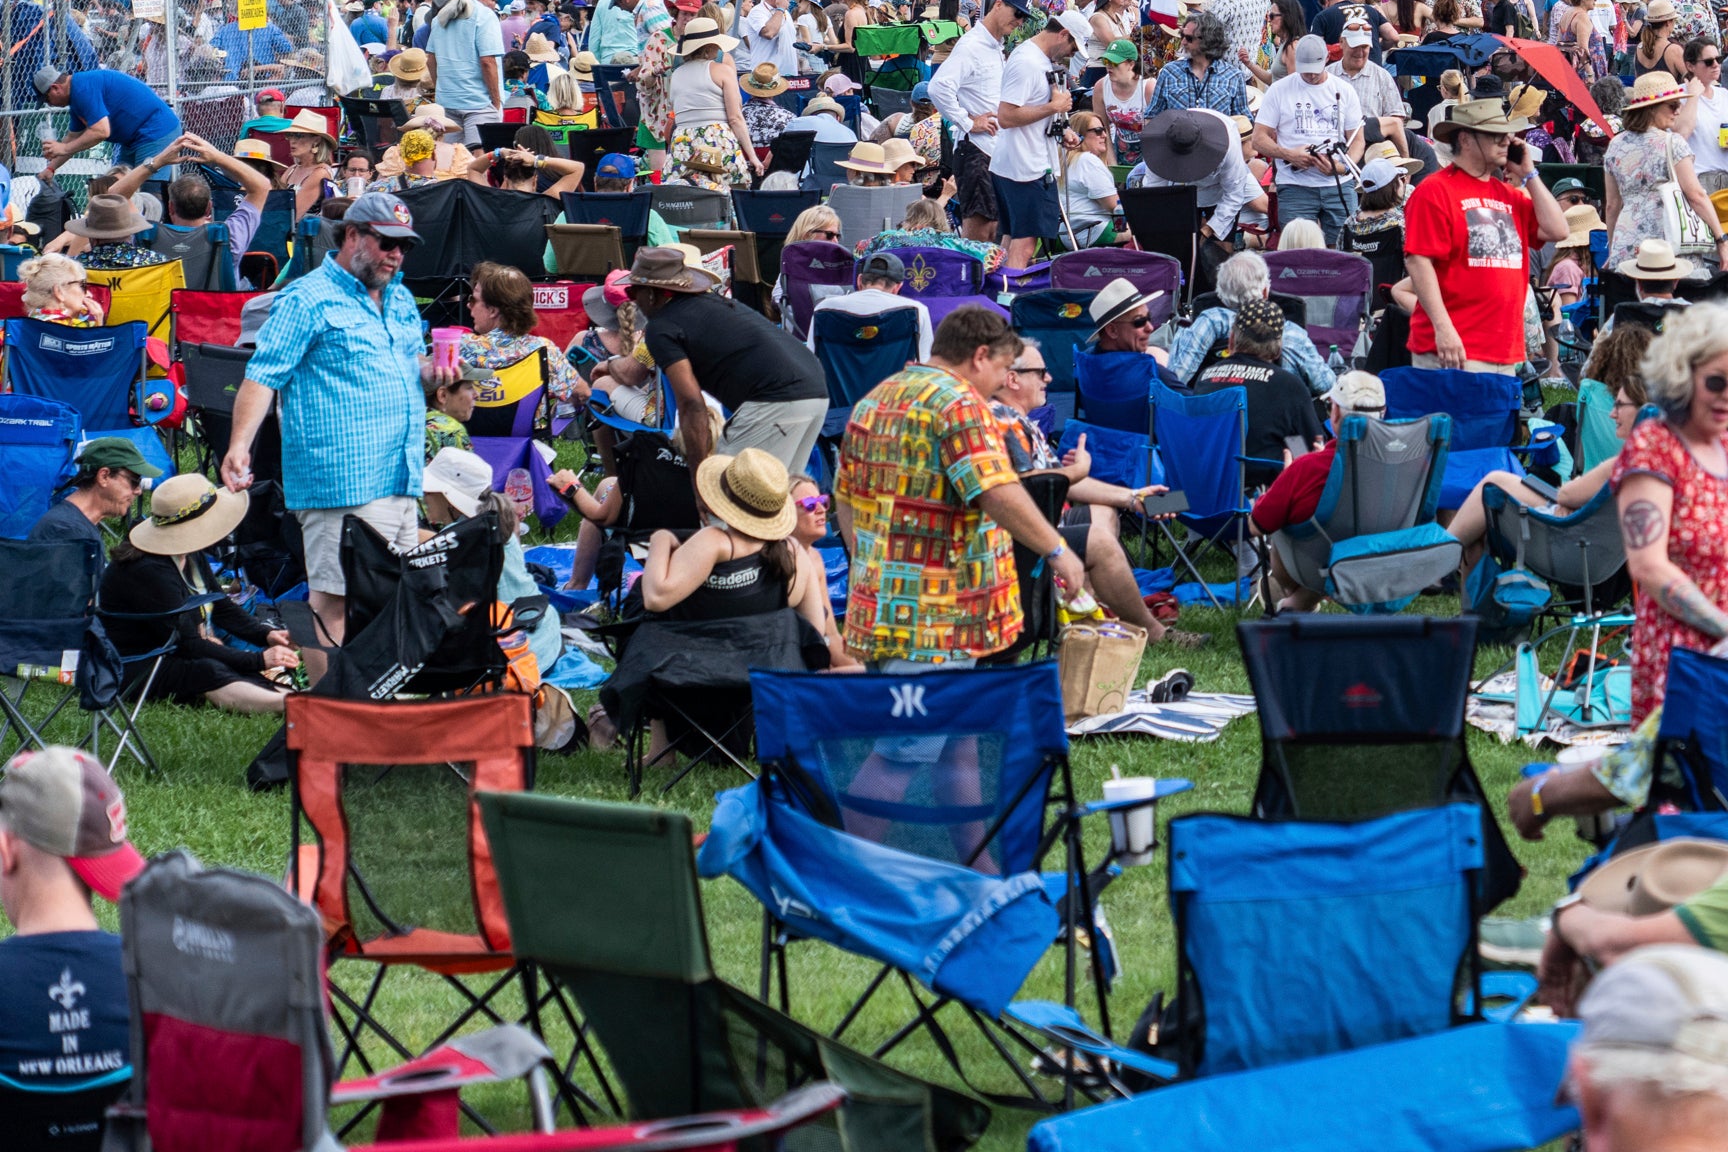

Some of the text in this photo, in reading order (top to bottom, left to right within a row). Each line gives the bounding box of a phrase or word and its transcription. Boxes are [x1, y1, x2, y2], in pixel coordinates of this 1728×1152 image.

[1343, 6, 1369, 20] 22
[49, 1008, 90, 1033] MADE
[62, 1035, 78, 1054] IN
[19, 1052, 123, 1075] NEW ORLEANS
